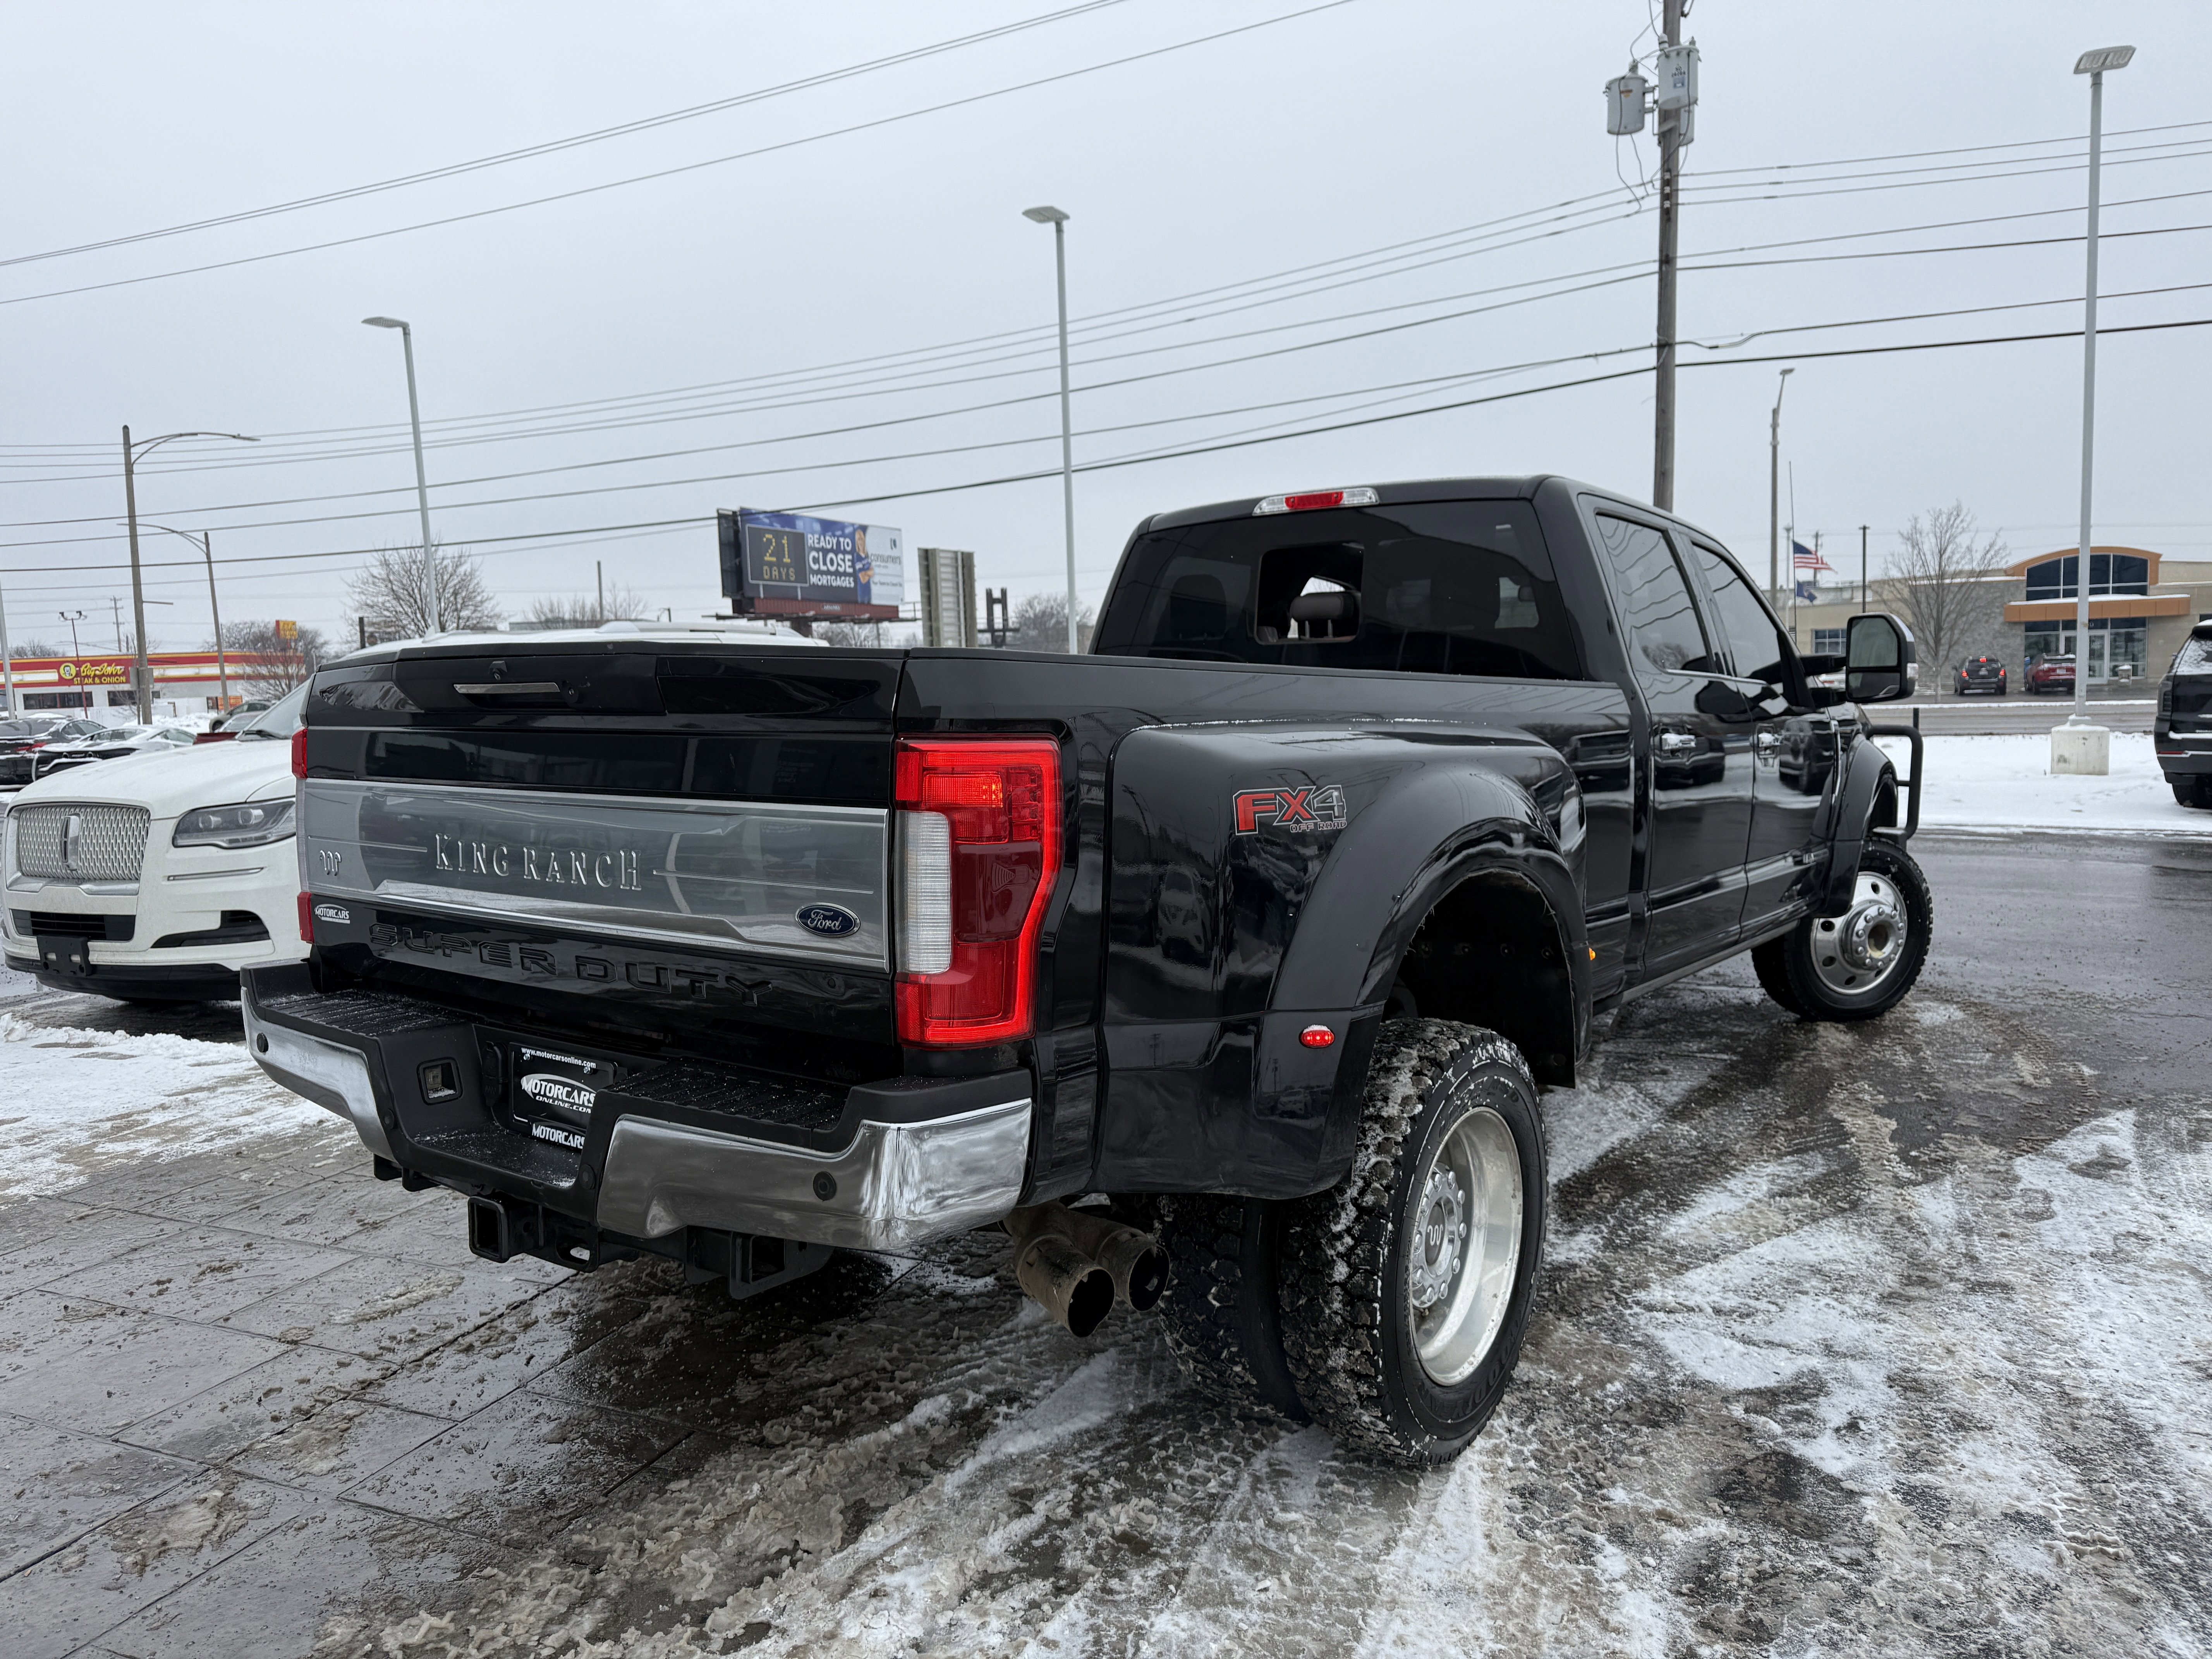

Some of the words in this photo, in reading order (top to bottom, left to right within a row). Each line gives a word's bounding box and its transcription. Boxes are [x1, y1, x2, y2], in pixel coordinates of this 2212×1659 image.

[763, 533, 791, 563] 21
[807, 534, 838, 550] READY
[839, 538, 852, 551] TO
[809, 550, 854, 573] CLOSE
[763, 566, 795, 581] DAYS
[809, 574, 855, 588] MORTGAGES
[81, 663, 95, 677] Big
[95, 663, 124, 675] John
[74, 677, 93, 685] STAK
[1233, 785, 1346, 836] FX4
[1290, 823, 1314, 833] OFF
[1317, 820, 1347, 830] ROAD
[436, 833, 509, 876] KING
[523, 845, 642, 891] RANCH
[315, 907, 349, 919] MOTORCARS
[808, 909, 842, 930] Ford
[369, 922, 558, 976] SUPER
[575, 955, 773, 1006] DUTY
[521, 1047, 596, 1069] www.motorcarsonline.com
[522, 1077, 596, 1107] MOTORCARS
